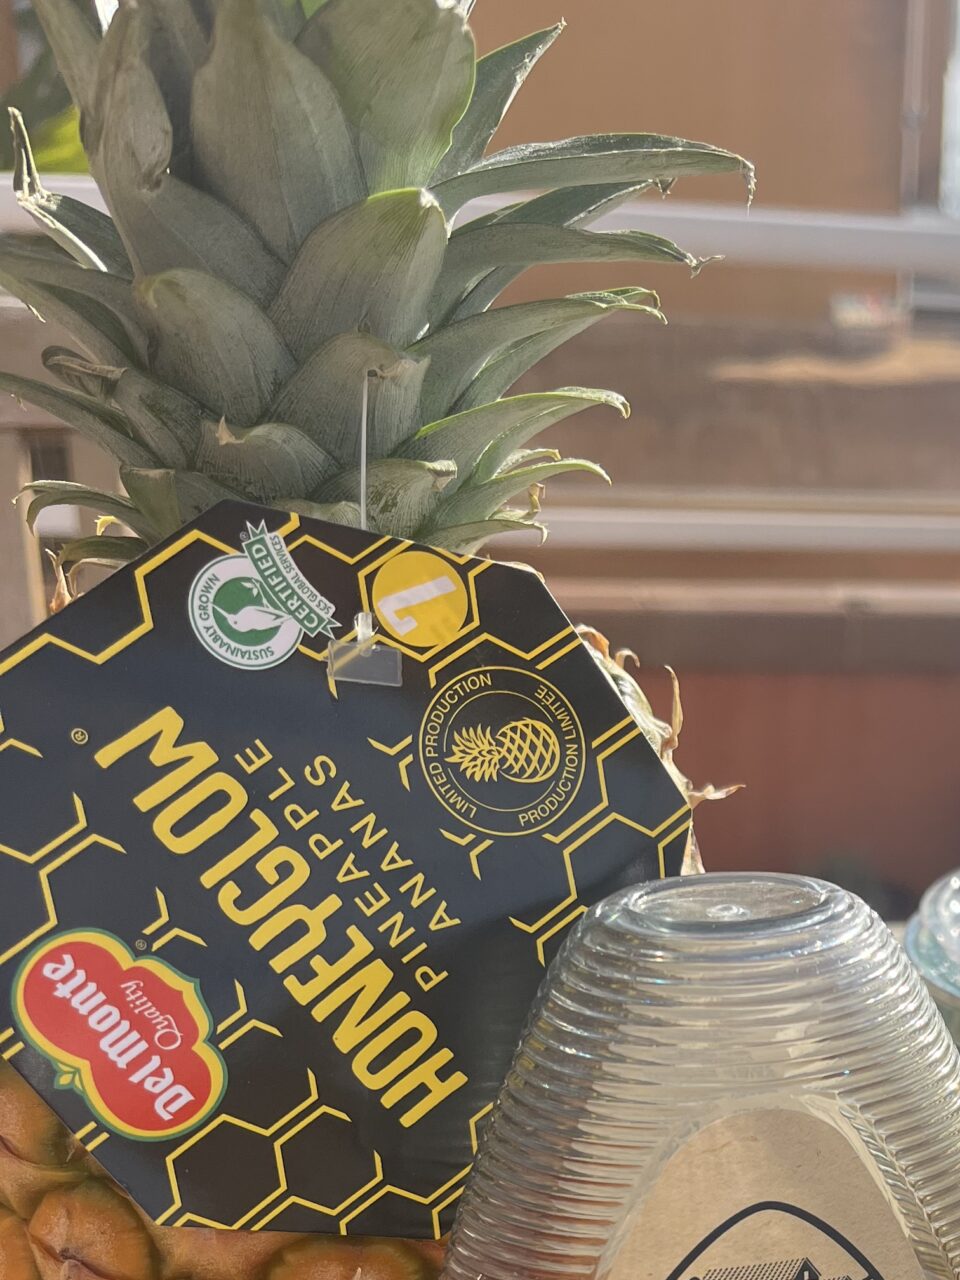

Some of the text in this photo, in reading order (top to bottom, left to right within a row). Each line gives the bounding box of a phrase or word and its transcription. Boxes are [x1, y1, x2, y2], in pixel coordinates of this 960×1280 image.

[198, 573, 275, 661] SUSTAINABLY GROWN
[251, 543, 319, 628] CERTIFIED
[270, 534, 332, 616] SCS GLOBAL SERVICES
[425, 672, 492, 819] LIMITED PRODUCTION
[518, 685, 579, 827] PRODUCTION LIMITÉE
[234, 738, 449, 992] PINEAPPLE
[304, 754, 462, 932] ANANAS
[94, 706, 469, 1128] HONEYGLOW
[42, 953, 195, 1121] Del Monte
[120, 979, 184, 1051] Quality
